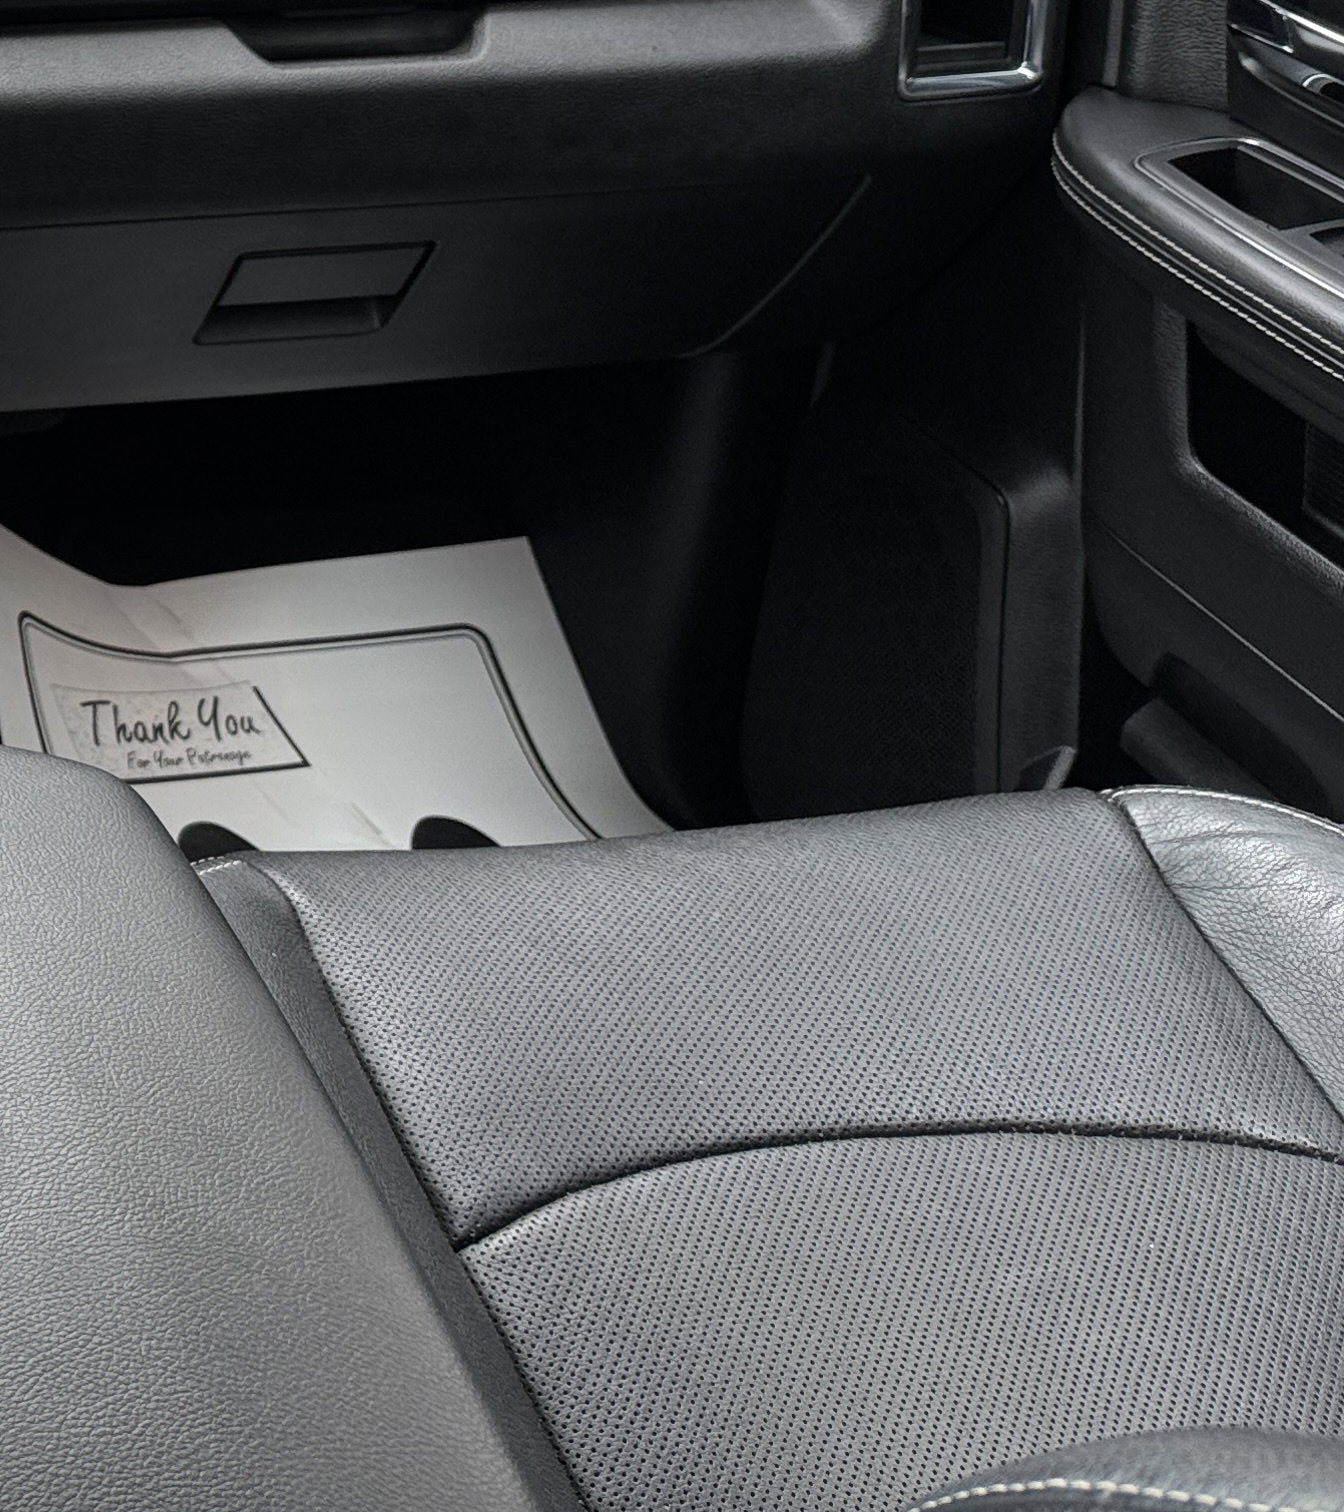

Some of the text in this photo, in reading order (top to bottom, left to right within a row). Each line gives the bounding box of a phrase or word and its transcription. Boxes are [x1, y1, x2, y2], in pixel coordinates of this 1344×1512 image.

[80, 696, 261, 746] Thank You
[127, 747, 252, 769] For Your Patronage
